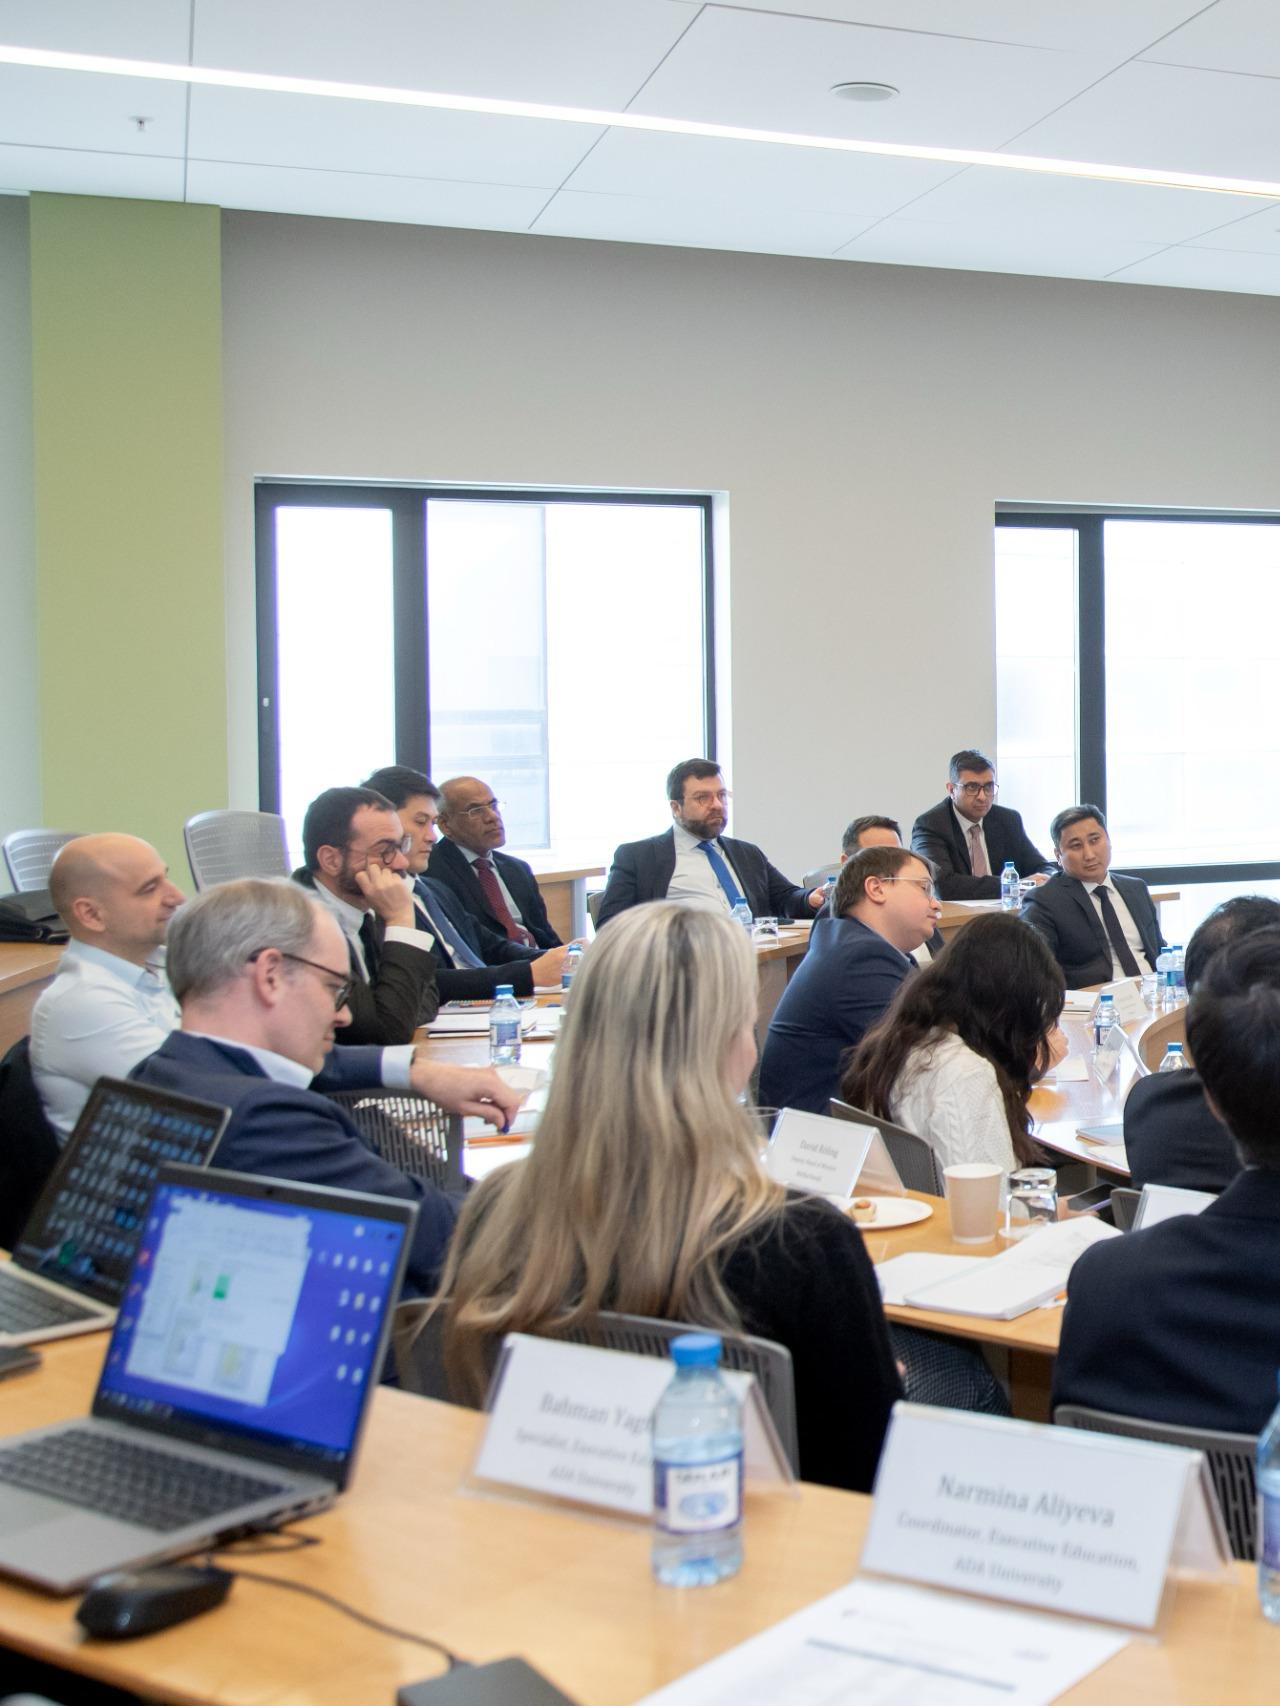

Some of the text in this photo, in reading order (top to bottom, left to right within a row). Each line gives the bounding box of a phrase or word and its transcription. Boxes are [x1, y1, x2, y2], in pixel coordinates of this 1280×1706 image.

[936, 1473, 1116, 1528] Narmina Aliyeva
[988, 1526, 1059, 1556] Executive
[952, 1555, 1064, 1596] ADA University
